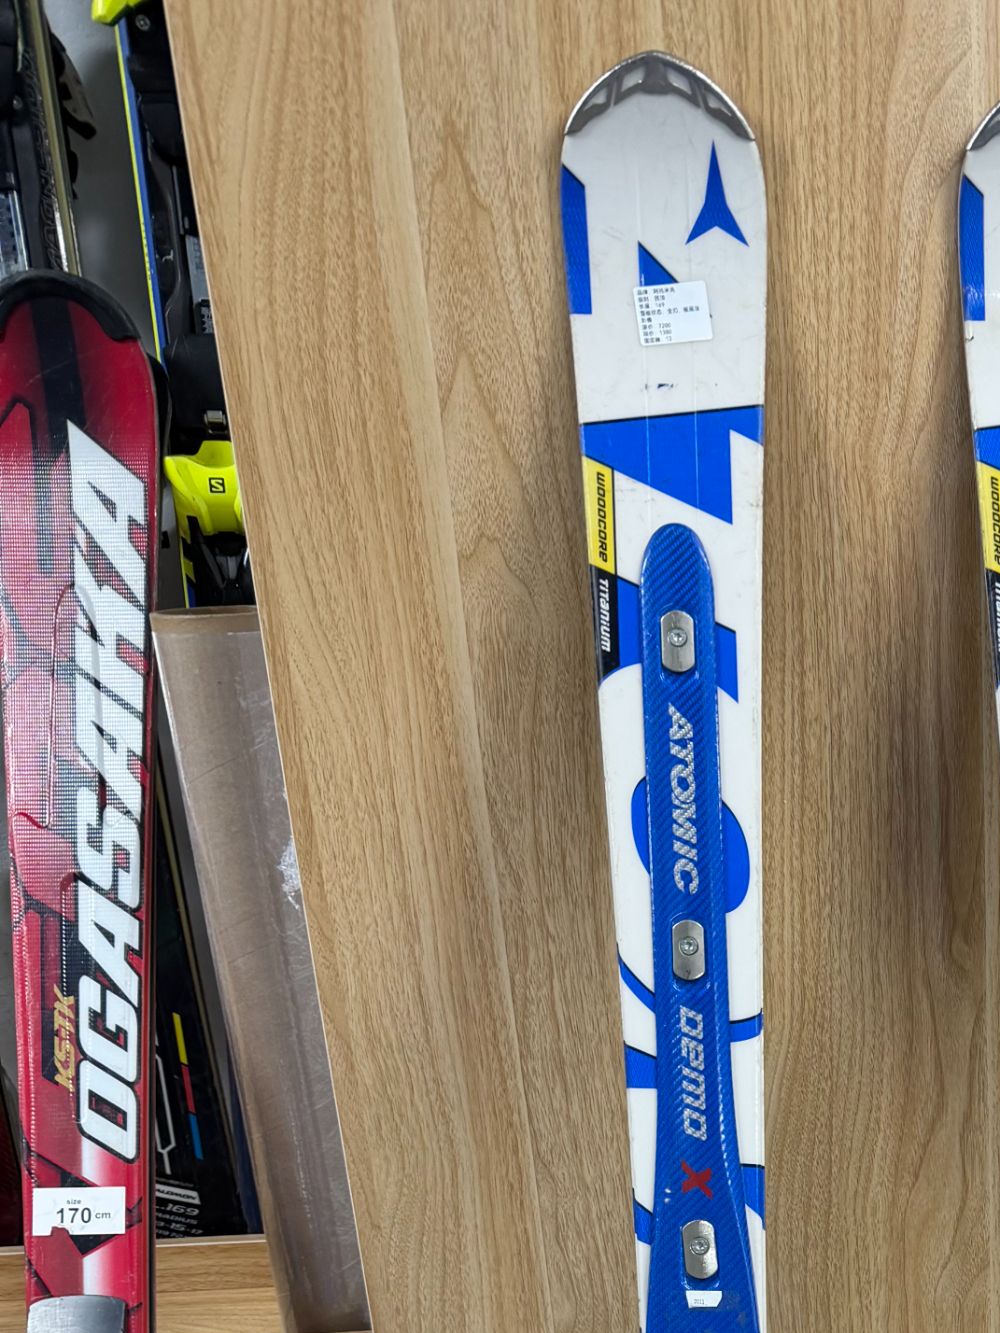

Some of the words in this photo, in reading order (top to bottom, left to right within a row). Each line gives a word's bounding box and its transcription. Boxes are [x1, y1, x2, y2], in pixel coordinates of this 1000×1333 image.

[67, 419, 148, 1161] OGASAKA
[668, 702, 699, 895] ATOMIC
[680, 1159, 714, 1200] X
[56, 1207, 92, 1225] 170
[95, 1211, 111, 1220] cm
[66, 1198, 82, 1206] size
